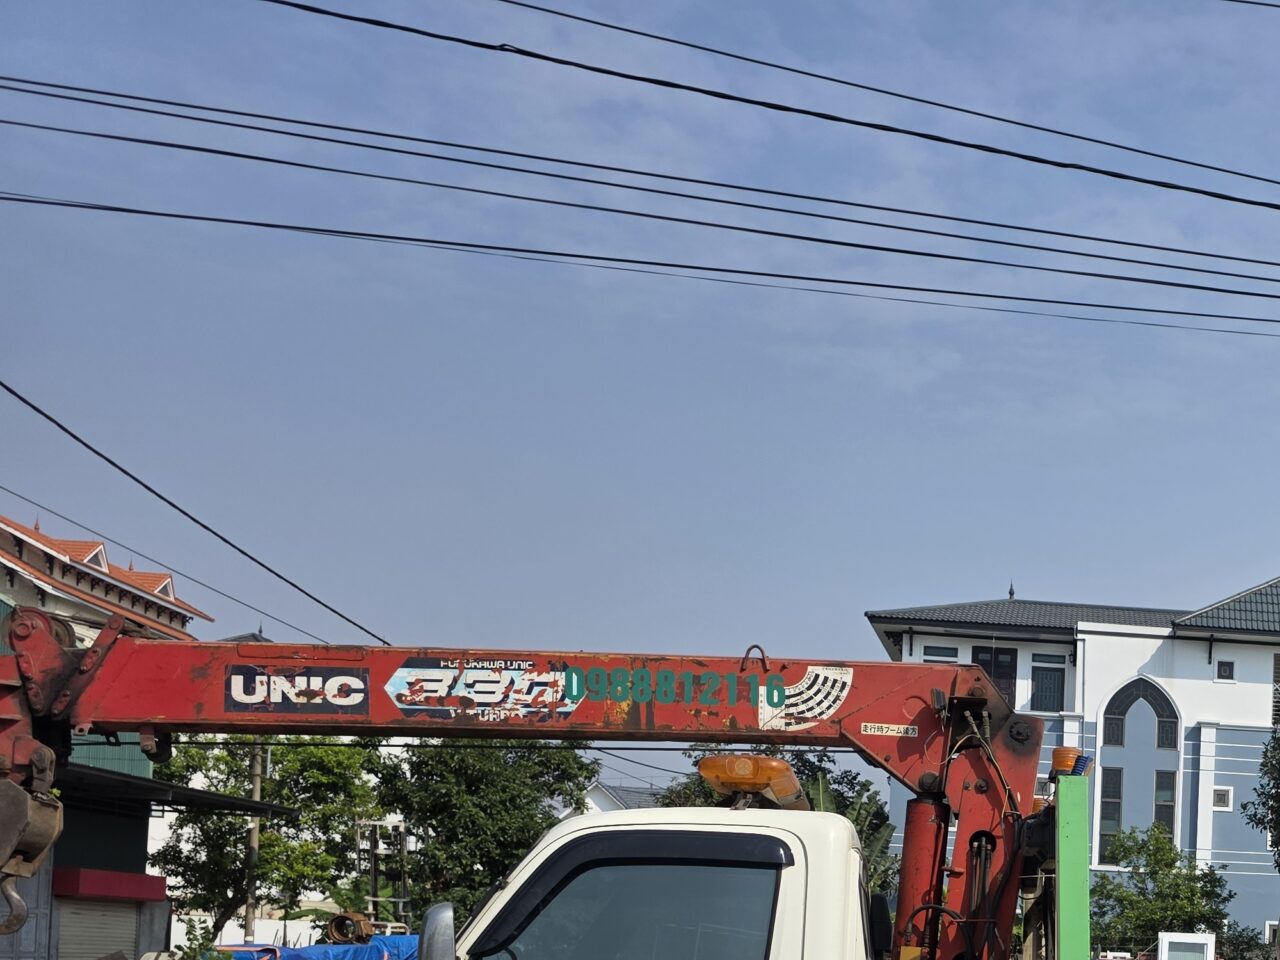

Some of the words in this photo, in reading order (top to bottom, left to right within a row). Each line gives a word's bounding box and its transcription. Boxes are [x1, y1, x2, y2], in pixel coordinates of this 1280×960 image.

[507, 661, 533, 669] UNIC
[231, 674, 367, 704] UNIC
[565, 666, 786, 708] 0988812116
